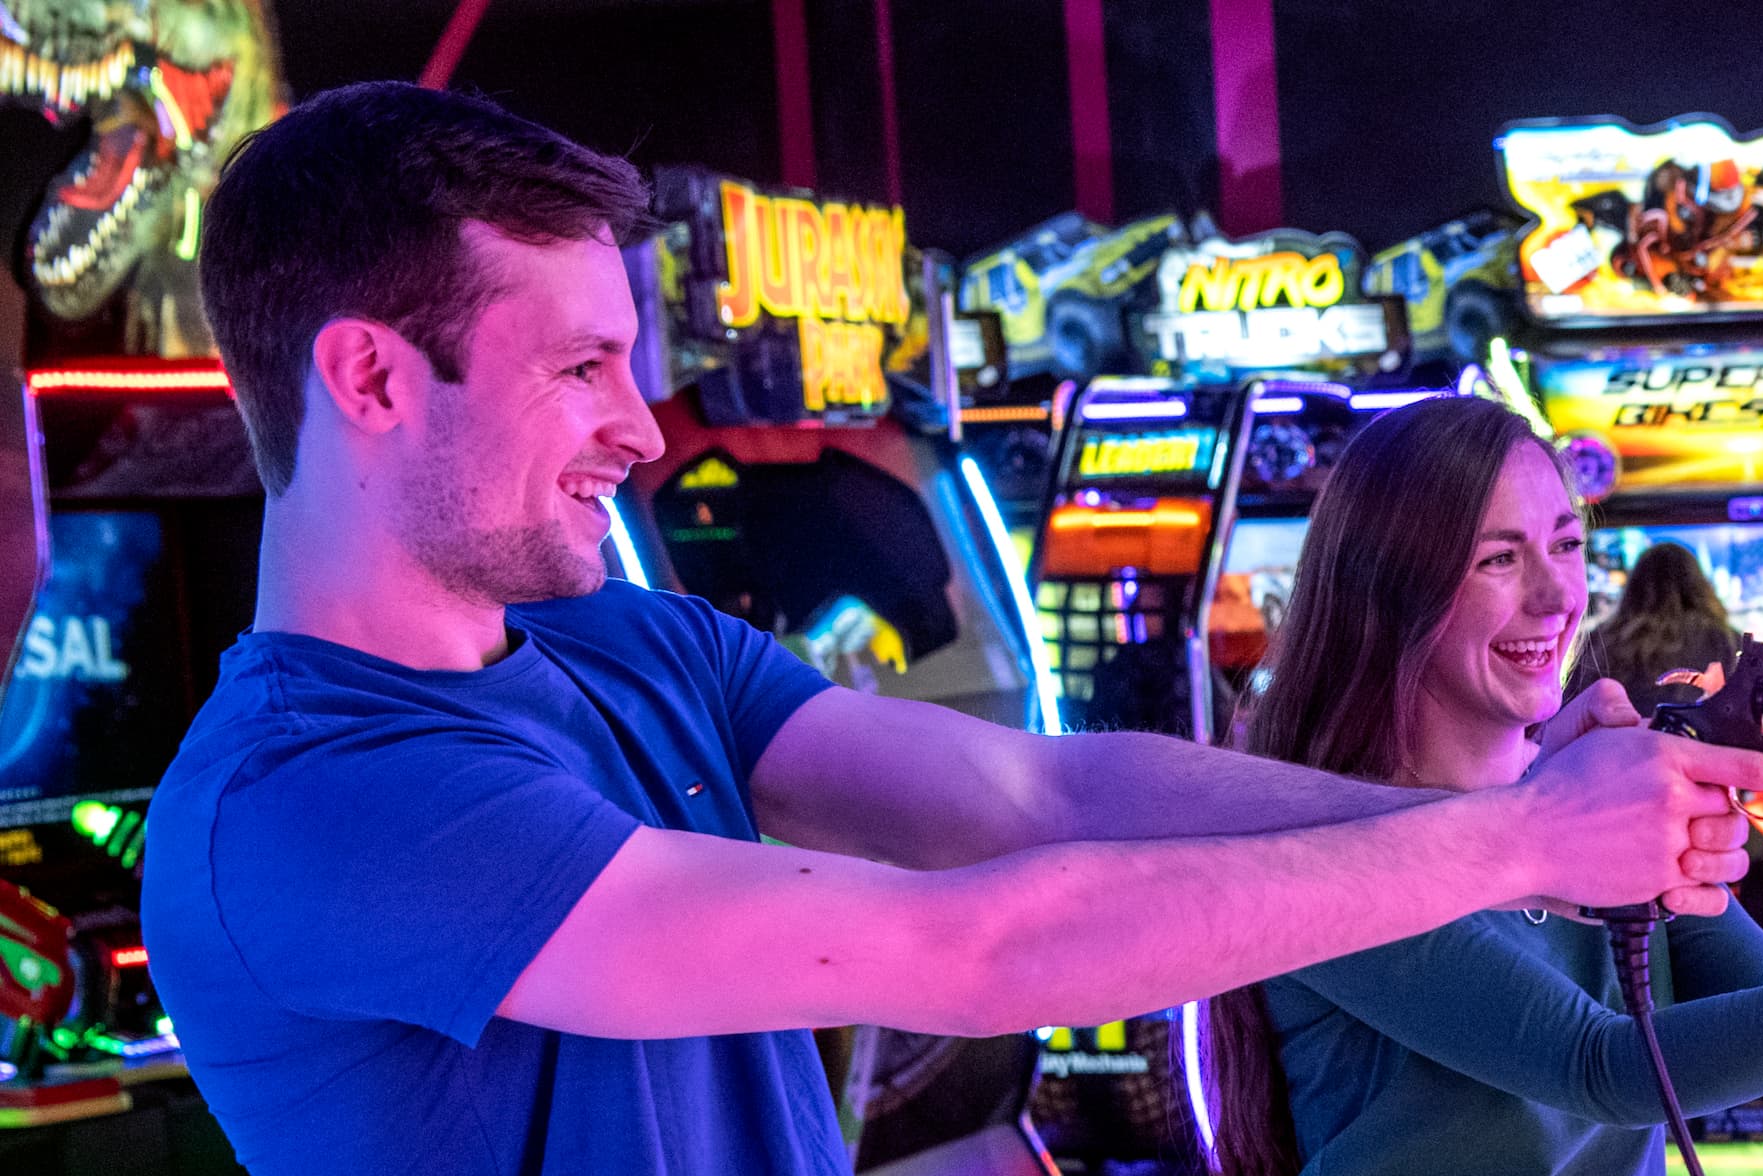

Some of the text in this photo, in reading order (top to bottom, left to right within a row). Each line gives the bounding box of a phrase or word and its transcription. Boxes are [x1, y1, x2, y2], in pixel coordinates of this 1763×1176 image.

[716, 180, 911, 330] JURASSIC
[1179, 251, 1344, 313] NITRO
[799, 317, 889, 411] PARK
[1143, 304, 1387, 360] TRUCKS
[15, 614, 130, 681] SAL
